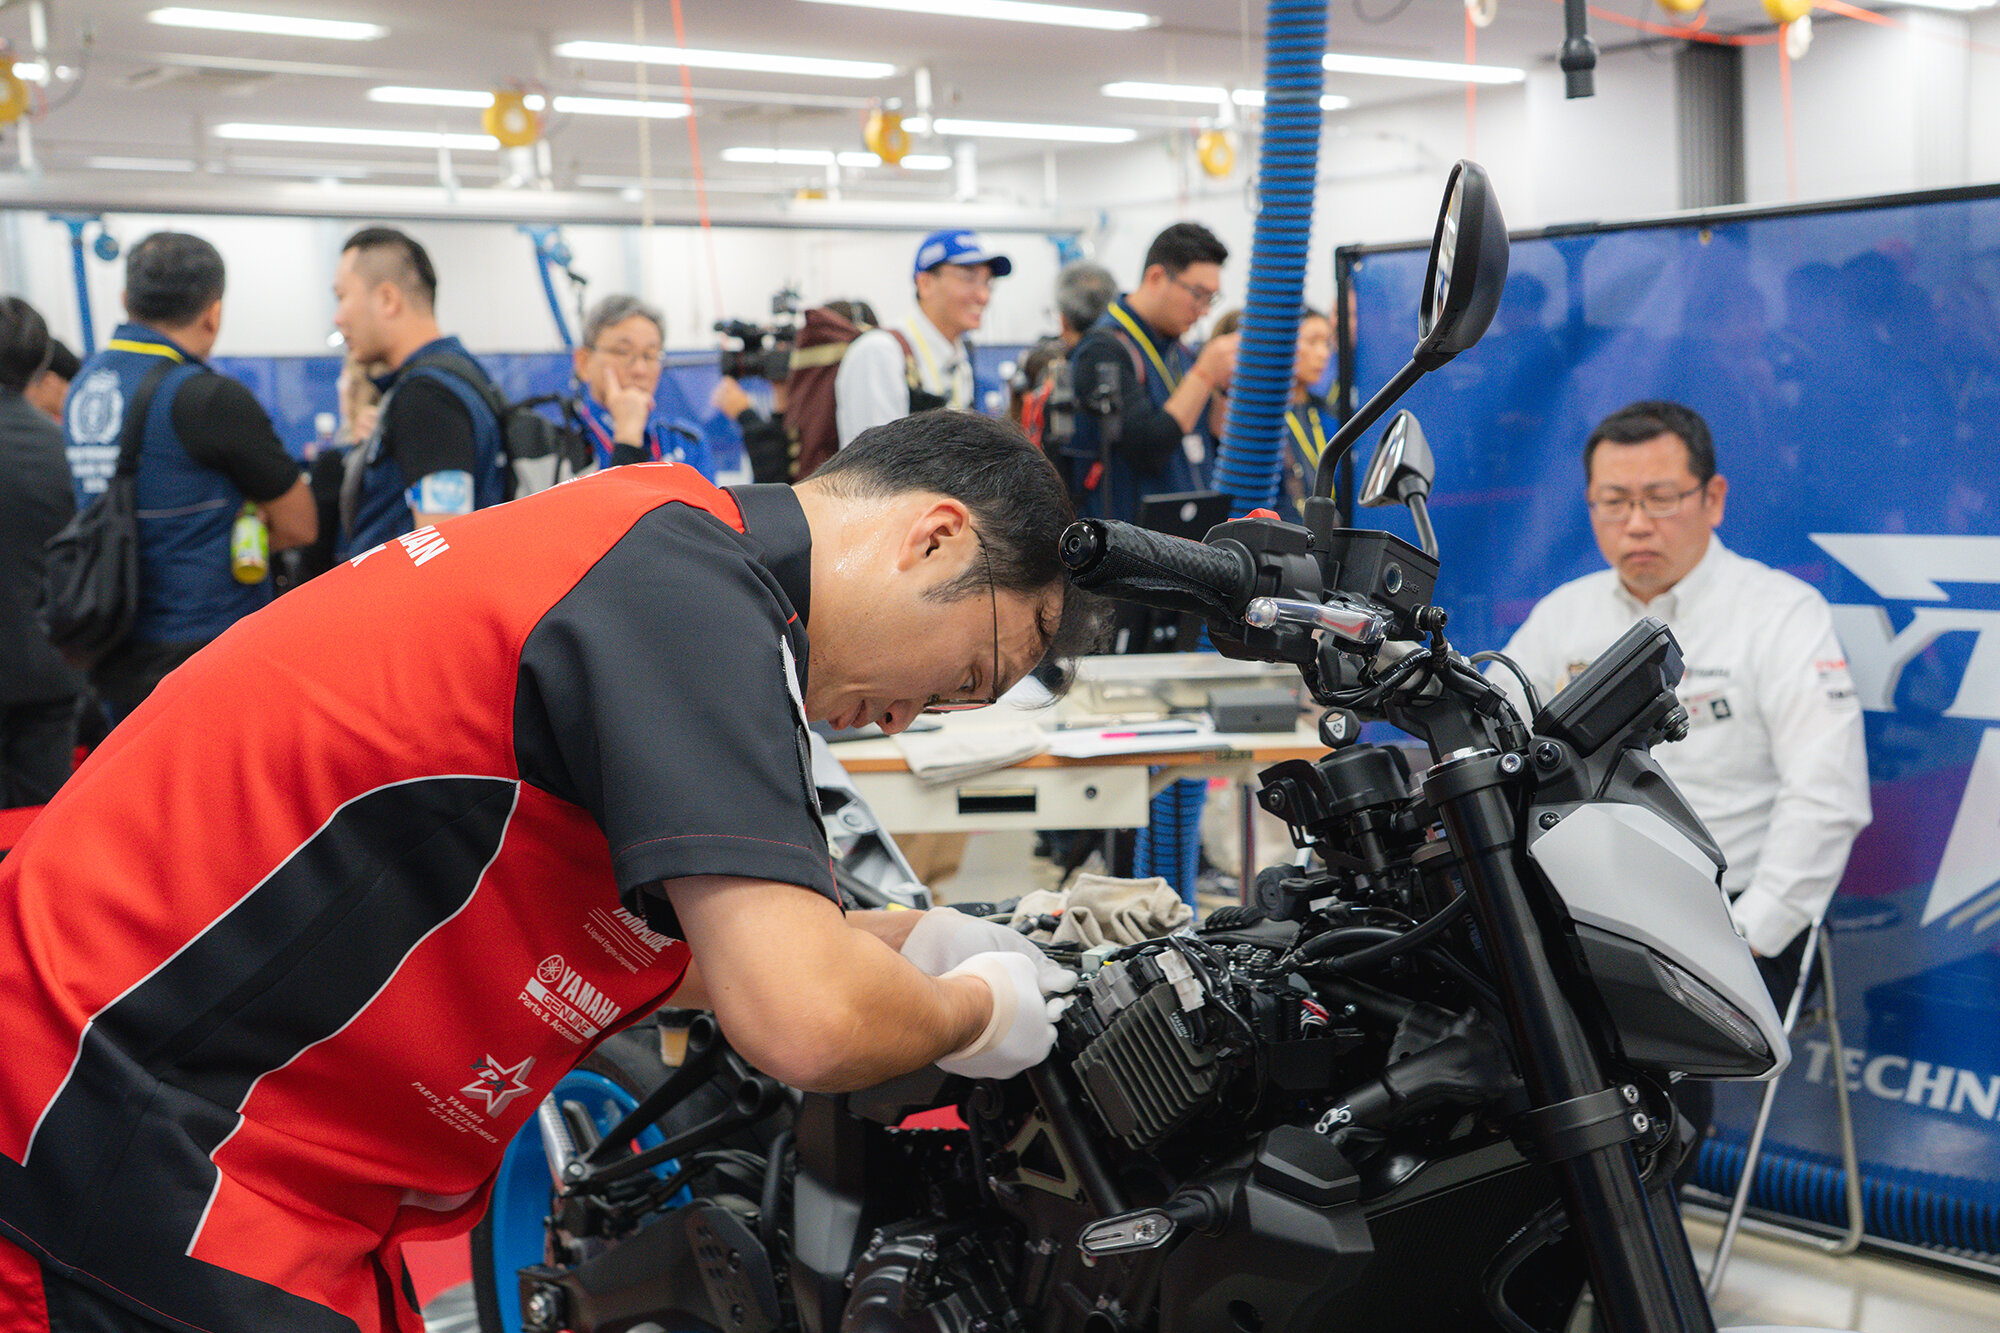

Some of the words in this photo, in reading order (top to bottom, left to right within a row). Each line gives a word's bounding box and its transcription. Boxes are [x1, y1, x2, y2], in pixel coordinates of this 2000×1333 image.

[517, 991, 543, 1017] Parts
[541, 1012, 551, 1023] &
[541, 992, 592, 1034] GENUINE
[556, 965, 622, 1029] YAMAHA
[411, 1081, 442, 1104] PARTS
[470, 1057, 507, 1093] YPA
[1804, 1040, 2000, 1121] TECHN
[446, 1095, 485, 1124] YAMAHA
